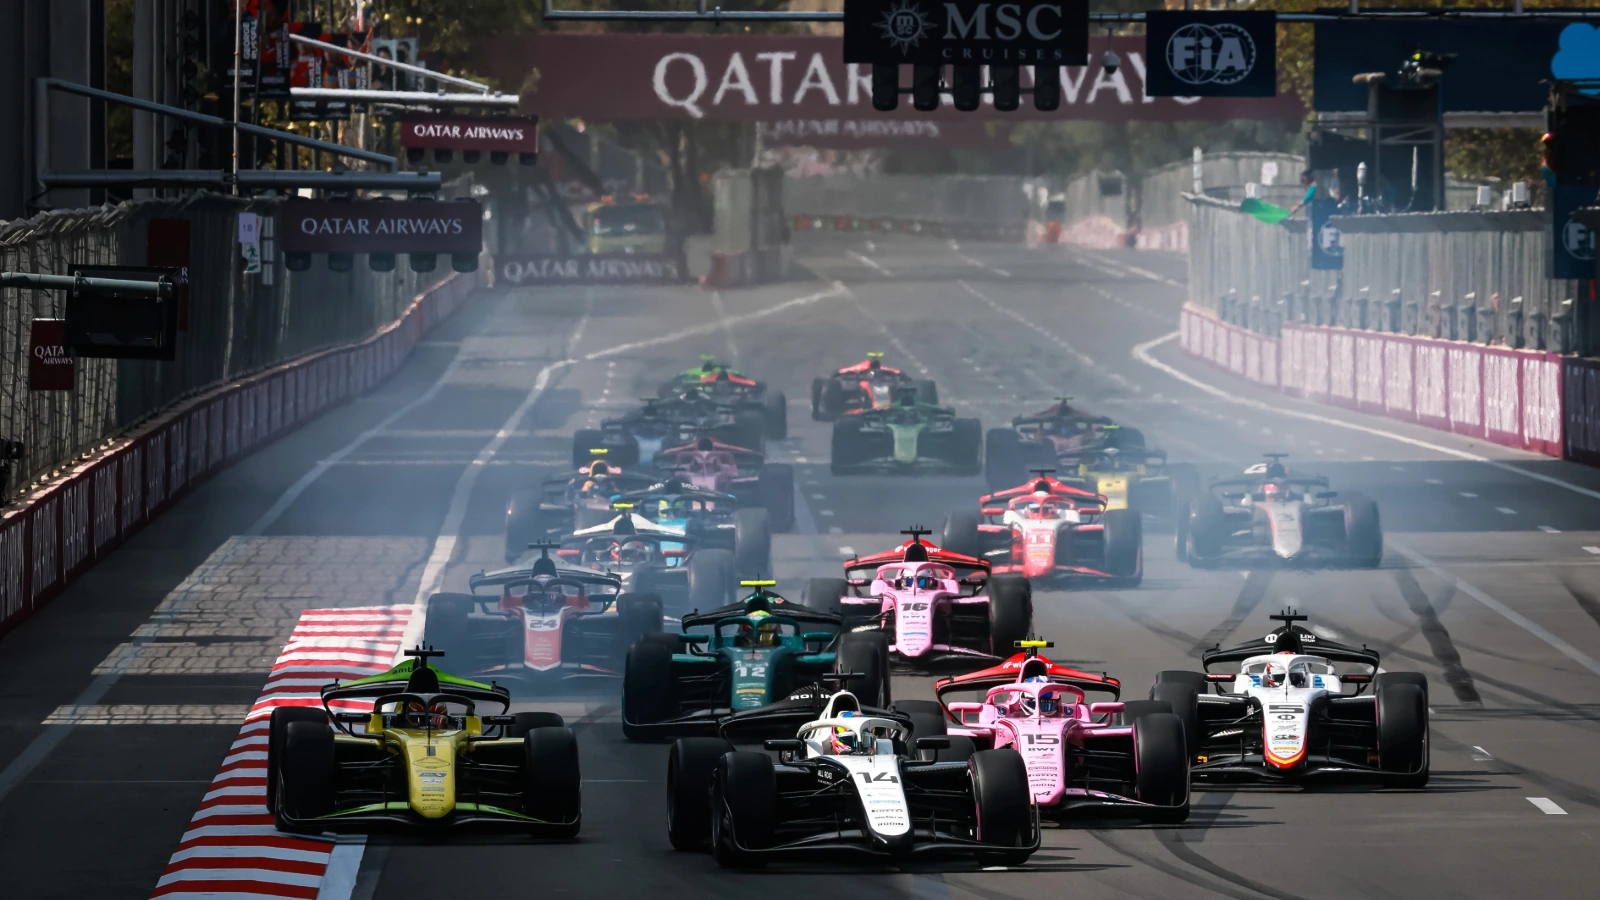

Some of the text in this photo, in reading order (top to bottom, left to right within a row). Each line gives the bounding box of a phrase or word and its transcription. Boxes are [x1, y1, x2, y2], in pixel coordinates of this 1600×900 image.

[942, 2, 1063, 41] MSC
[942, 48, 1063, 60] CRUISES
[413, 124, 524, 141] QATAR AIRWAYS
[301, 217, 463, 235] QATAR AIRWAYS
[503, 259, 579, 284] QATAR
[34, 346, 64, 358] QATA
[901, 602, 929, 612] 16
[529, 619, 558, 629] 24
[734, 666, 766, 677] 12
[1268, 704, 1305, 714] 5
[1021, 733, 1060, 745] 15
[855, 771, 900, 784] 14
